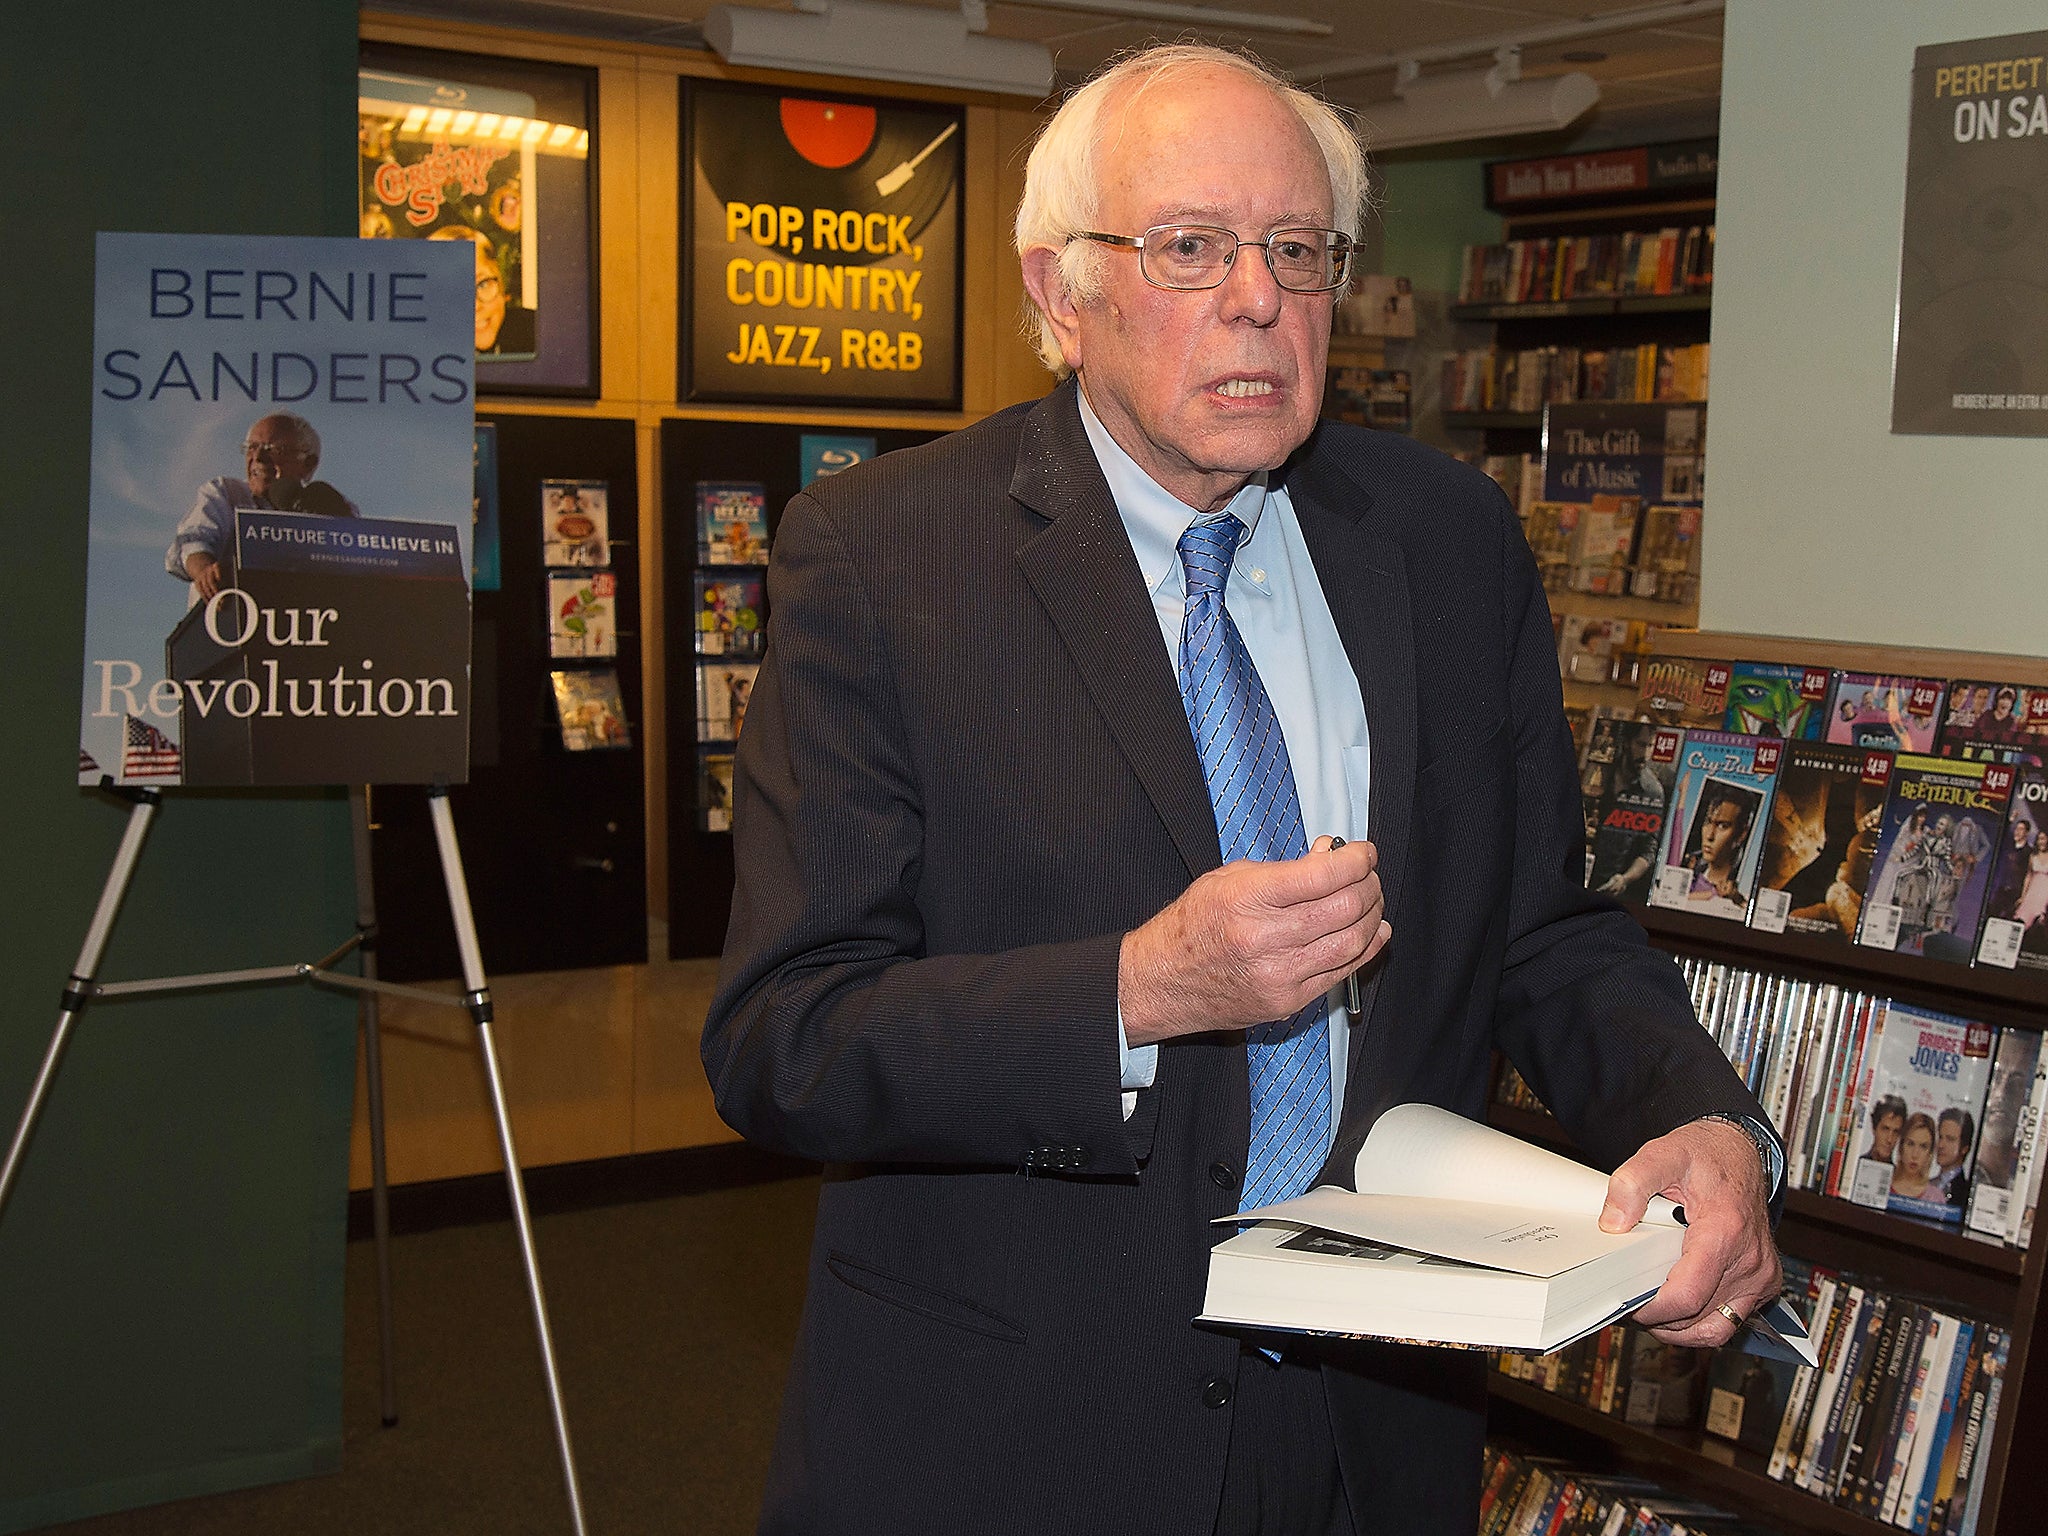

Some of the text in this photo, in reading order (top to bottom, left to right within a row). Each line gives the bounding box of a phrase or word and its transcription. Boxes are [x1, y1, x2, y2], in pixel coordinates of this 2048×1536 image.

[1935, 57, 2043, 98] PERFECT
[1953, 99, 1999, 143] ON
[727, 202, 923, 260] POP, ROCK,
[150, 268, 427, 323] BERNIE
[727, 258, 923, 320] COUNTRY,
[728, 324, 923, 374] JAZZ, R&B
[101, 350, 469, 404] SANDERS
[1564, 429, 1640, 455] The Gift
[1561, 460, 1640, 489] of Music
[245, 525, 453, 555] A FUTURE TO BELIEVE IN
[204, 588, 338, 648] Our
[92, 659, 458, 719] Revolution
[1793, 758, 1835, 772] BATMAN
[1900, 780, 1994, 813] BEETLEJUICE
[1603, 808, 1662, 833] ARGO
[1909, 1046, 1961, 1075] JONES
[2020, 1106, 2039, 1174] capote
[1827, 1298, 1857, 1374] Deliverance
